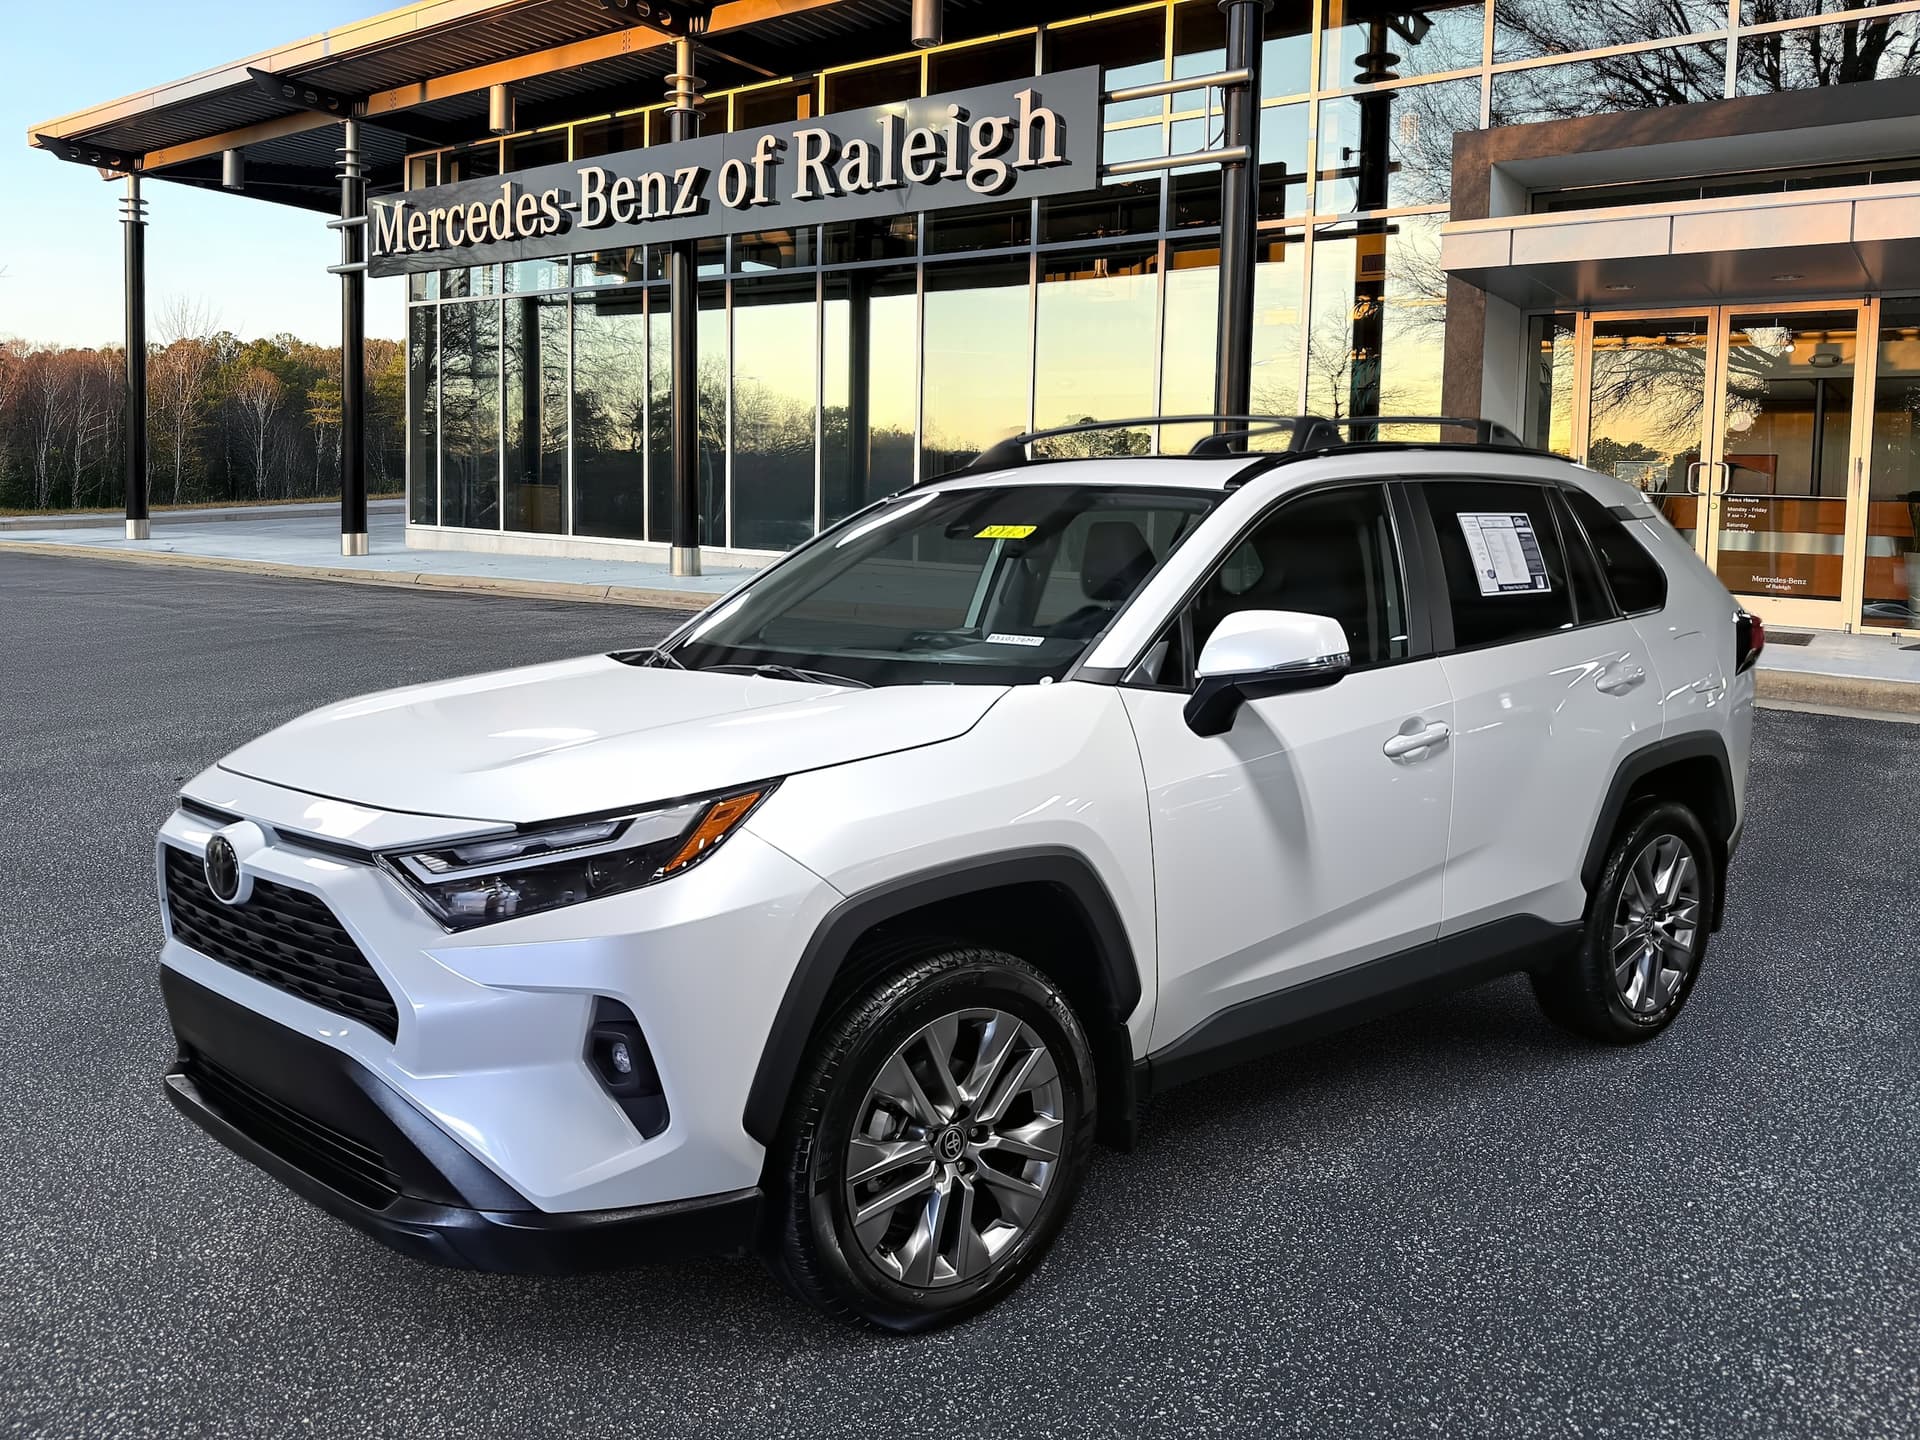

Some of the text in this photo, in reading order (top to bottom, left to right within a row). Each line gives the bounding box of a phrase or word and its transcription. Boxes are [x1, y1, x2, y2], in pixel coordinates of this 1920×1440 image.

[371, 87, 1065, 257] Mercedes-Benz of Raleigh
[1751, 575, 1807, 585] Mercedes-Benz
